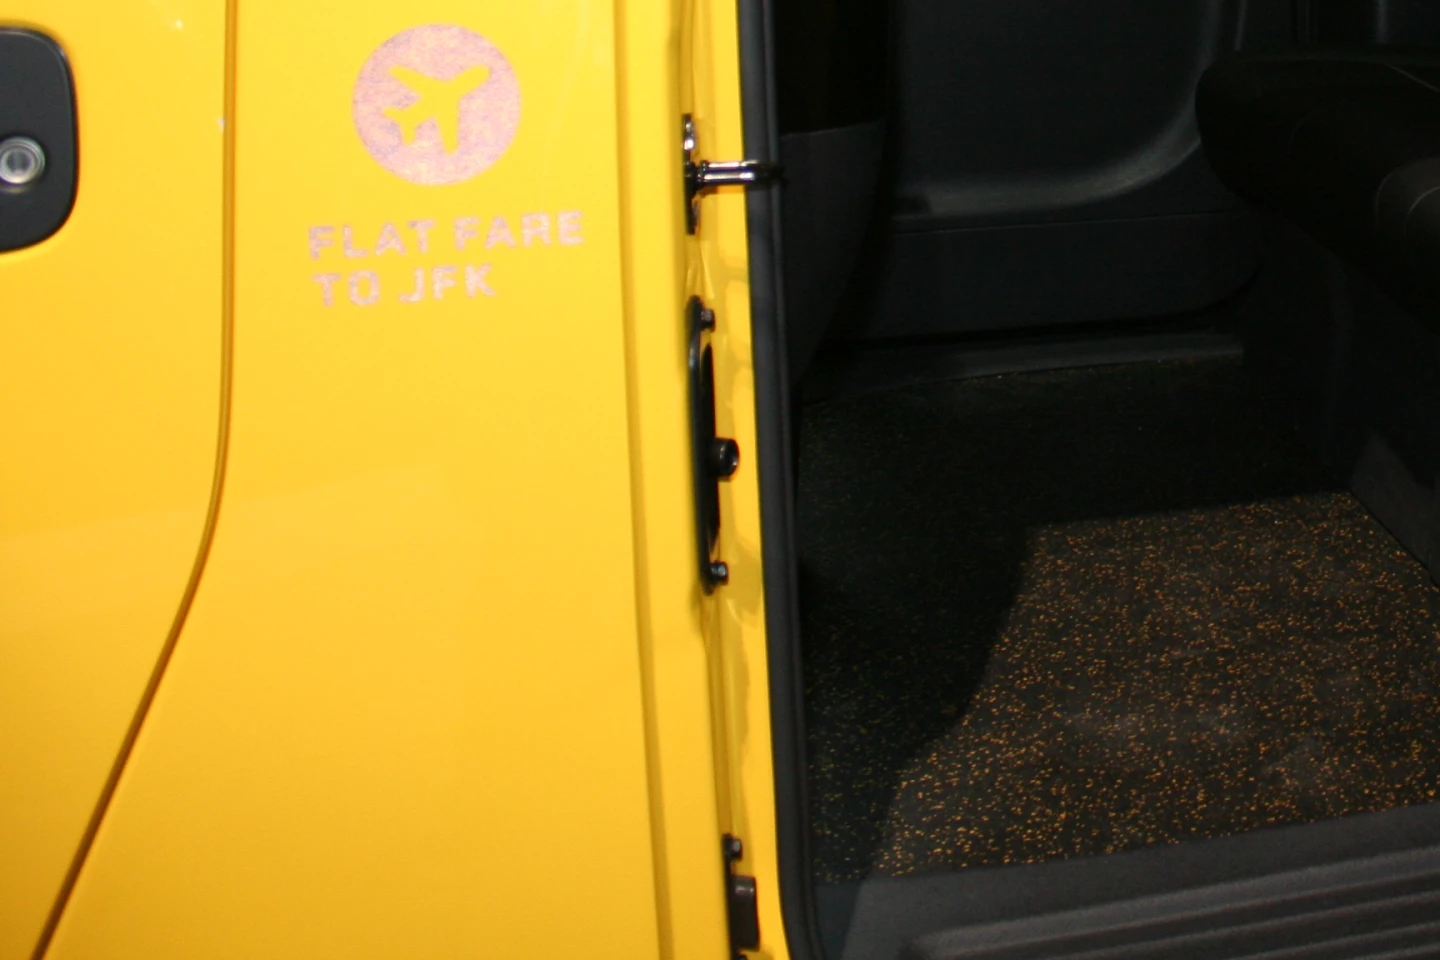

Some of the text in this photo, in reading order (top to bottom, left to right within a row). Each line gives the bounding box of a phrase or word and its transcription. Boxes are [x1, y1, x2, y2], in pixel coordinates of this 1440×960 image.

[308, 210, 585, 260] FLAT FARE
[312, 263, 496, 308] TO JFK
